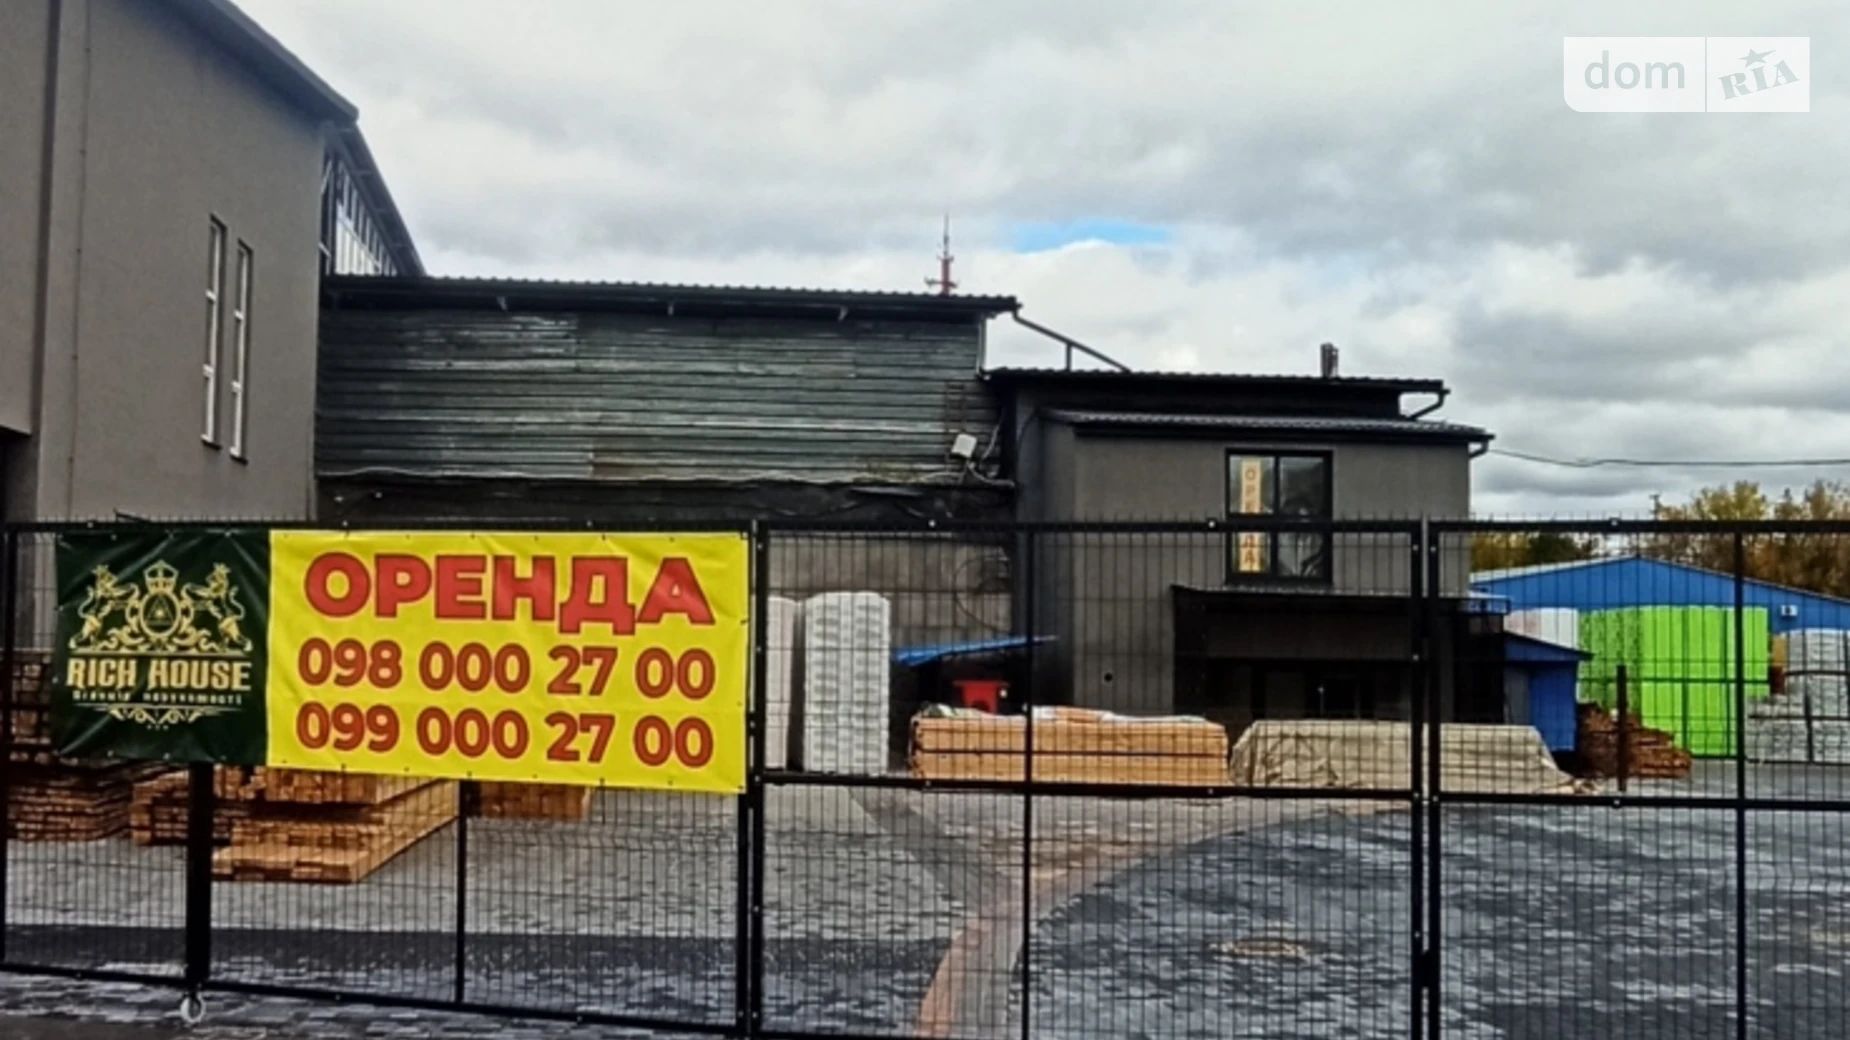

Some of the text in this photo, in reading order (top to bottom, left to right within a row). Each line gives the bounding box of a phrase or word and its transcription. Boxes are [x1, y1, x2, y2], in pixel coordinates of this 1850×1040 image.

[303, 551, 716, 637] ОРЕНДА
[66, 657, 252, 691] RICH HOUSE
[298, 637, 716, 700] 098 000 27 00
[296, 701, 714, 769] 099 000 27 00
